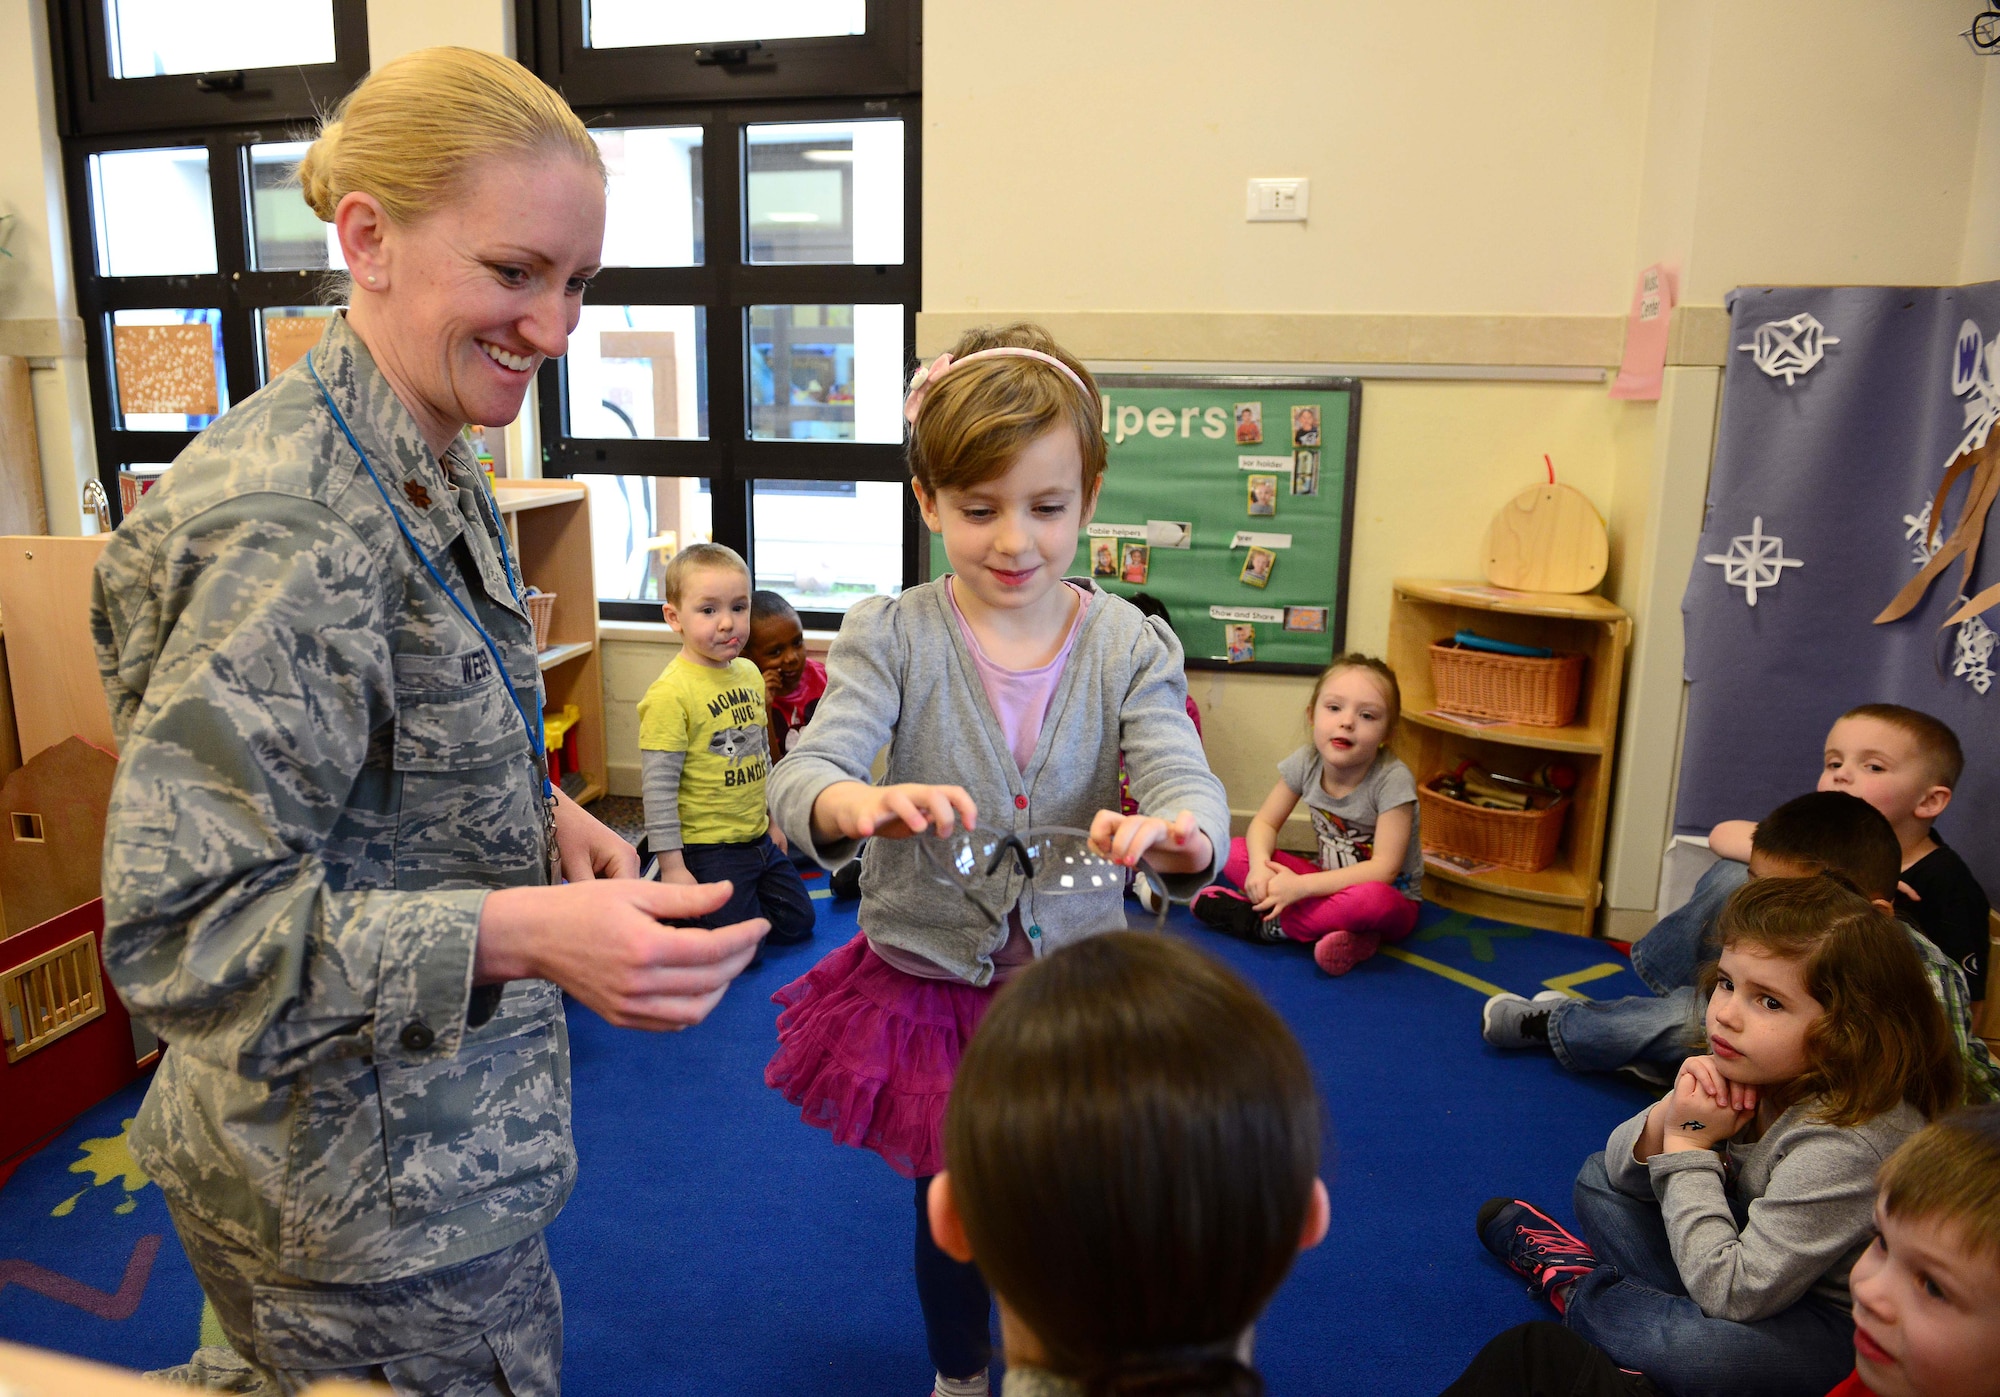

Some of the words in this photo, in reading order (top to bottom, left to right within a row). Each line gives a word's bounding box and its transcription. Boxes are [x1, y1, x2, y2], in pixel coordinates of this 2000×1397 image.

[1112, 528, 1141, 537] helpers
[1211, 609, 1232, 617] Show
[1234, 611, 1250, 619] and
[1252, 612, 1275, 620] Share
[731, 705, 755, 725] HUG
